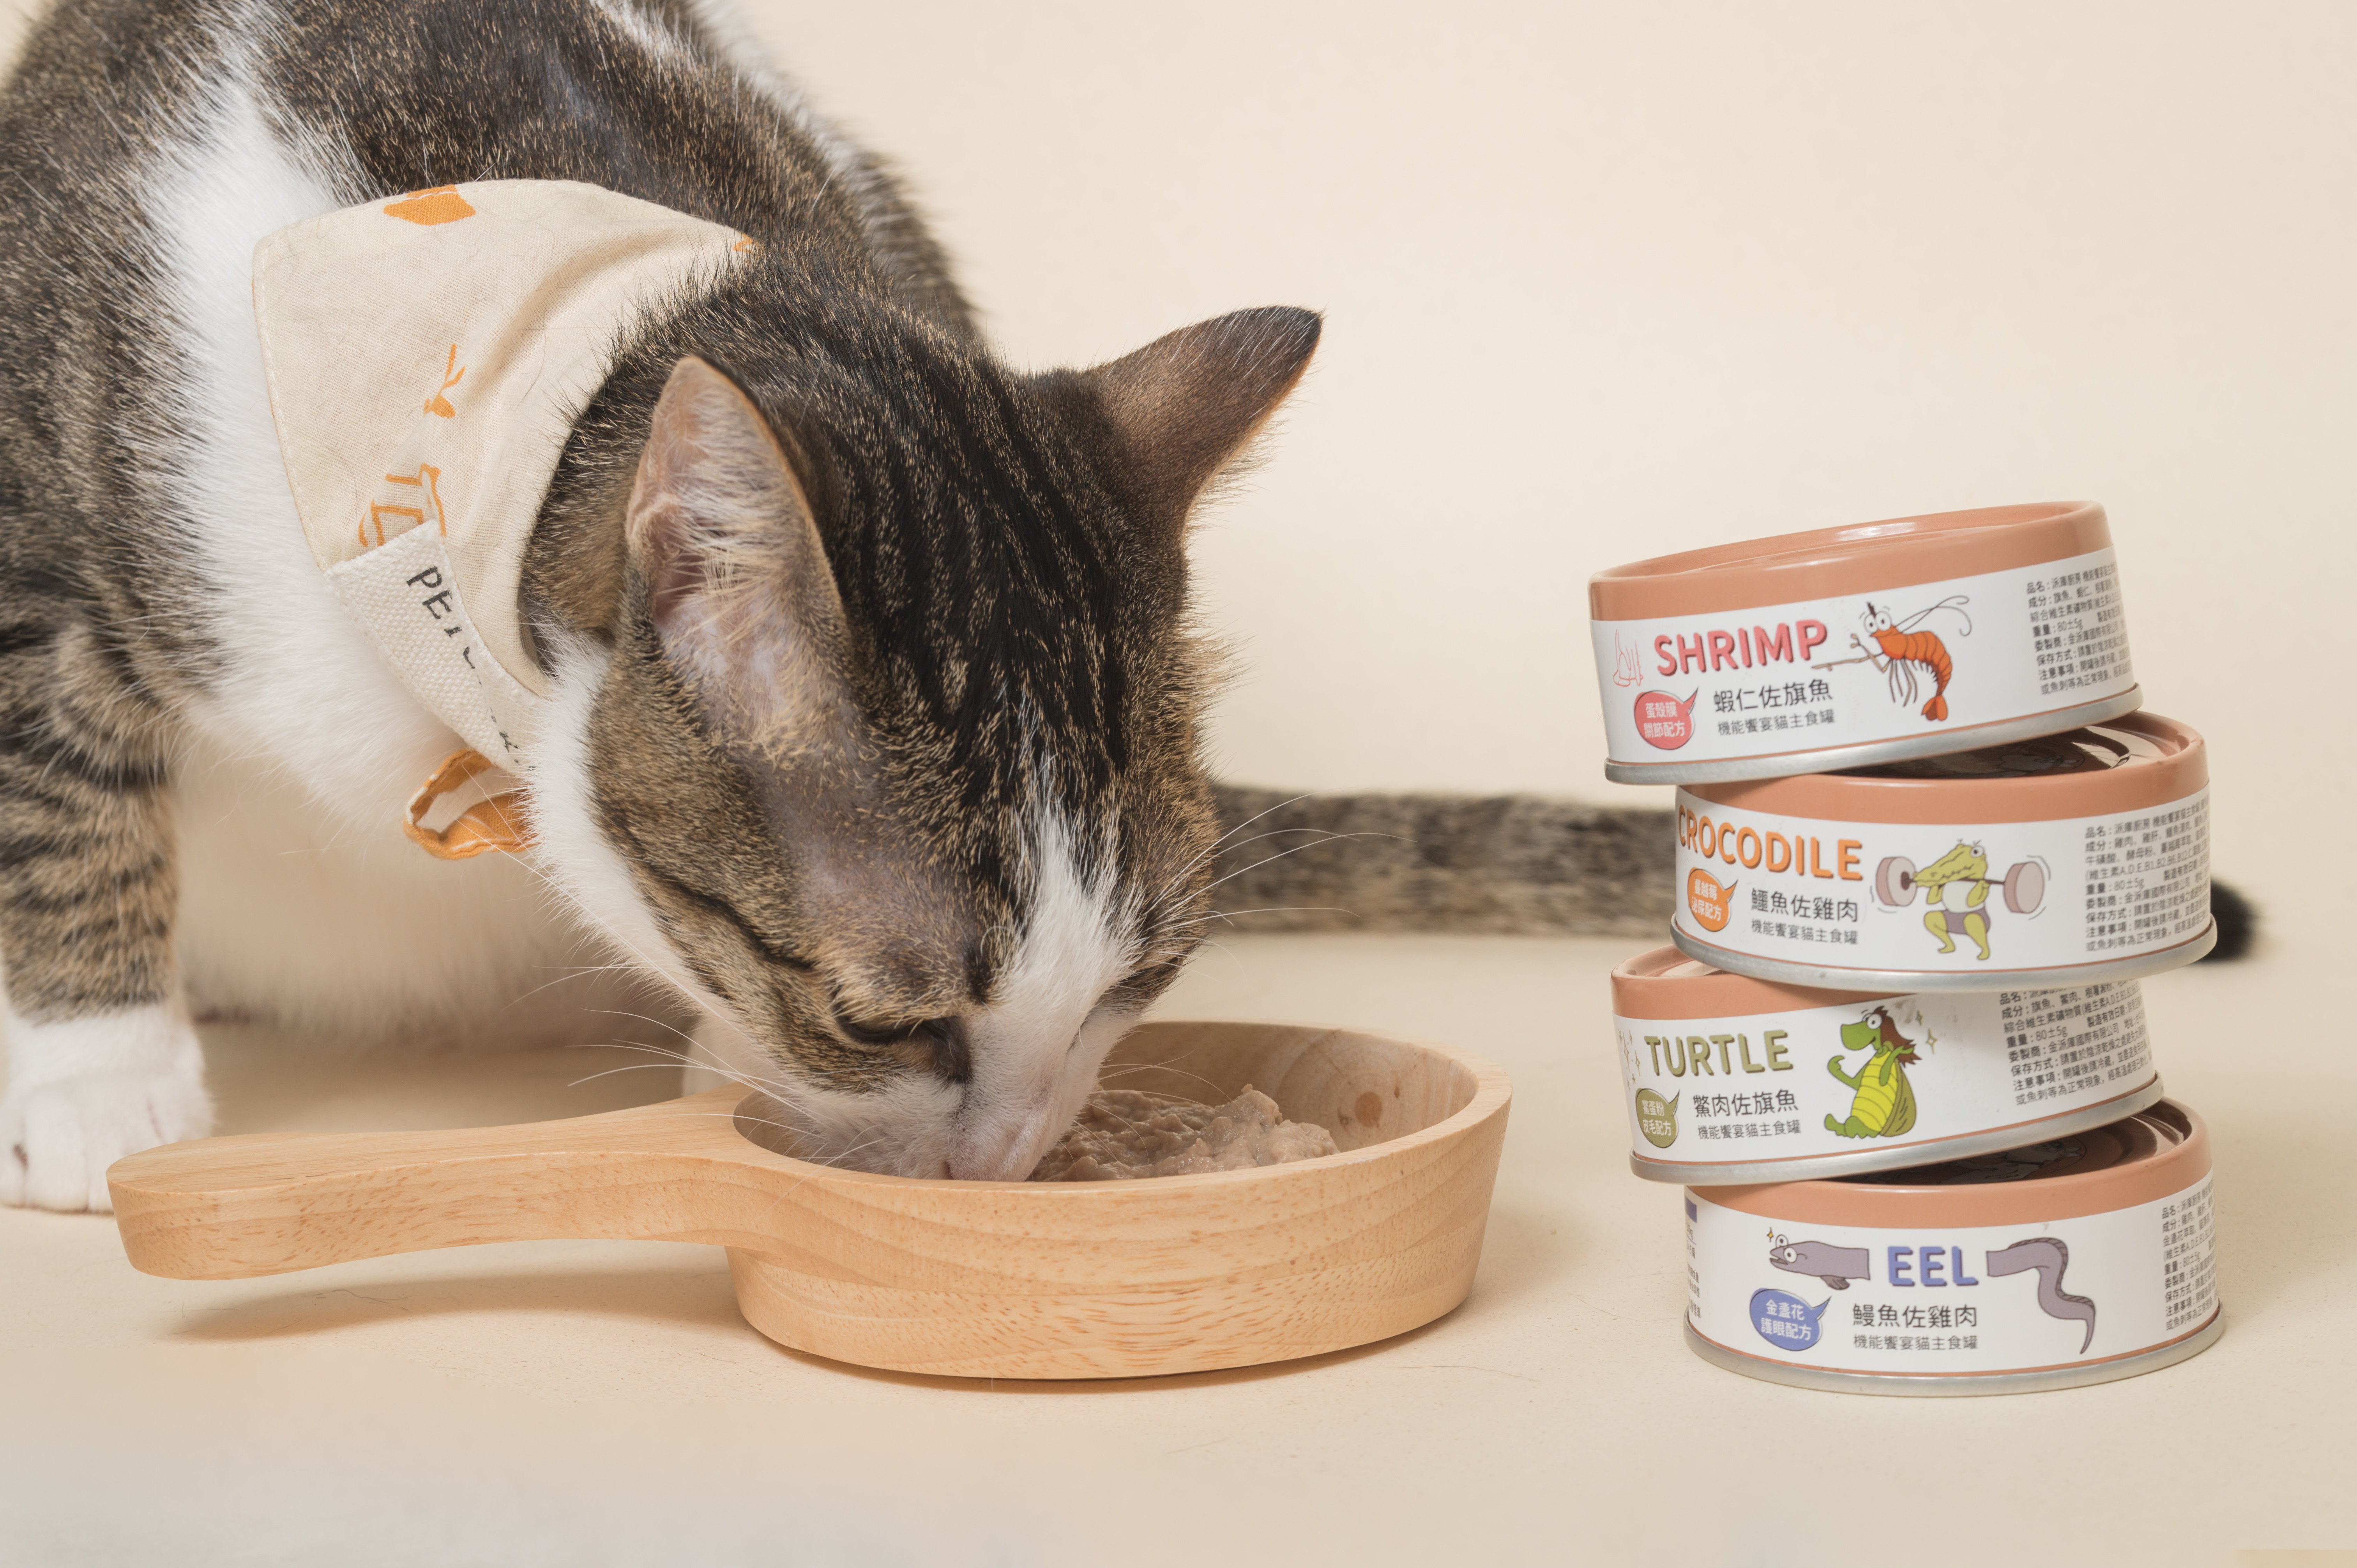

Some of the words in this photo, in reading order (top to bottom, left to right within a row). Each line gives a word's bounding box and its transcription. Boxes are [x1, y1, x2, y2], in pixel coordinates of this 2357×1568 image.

[1654, 619, 1828, 676] SHRIMP
[1714, 678, 1833, 713] 蝦仁佐旗魚
[1645, 702, 1677, 718] 蛋殼膜
[1717, 709, 1835, 736] 機能饗宴貓主食罐
[1643, 720, 1685, 738] 關節配方
[1678, 804, 1863, 881] CROCODILE
[1694, 879, 1717, 901] 蔓越莓
[1692, 896, 1722, 921] 泌尿配方
[1751, 888, 1857, 923] 鱷魚佐雞肉
[1751, 919, 1858, 945] 機能饗宴貓主食罐
[1644, 1029, 1794, 1077] TURTLE
[1693, 1089, 1799, 1118] 鱉肉佐旗魚
[1643, 1118, 1671, 1136] 皮毛配方
[1698, 1119, 1801, 1140] 機能饗宴貓主食罐
[1887, 1246, 1979, 1287] EEL
[1766, 1299, 1805, 1320] 金盞花
[1853, 1303, 1977, 1328] 鰻魚佐雞肉
[1761, 1317, 1812, 1340] 護眼配方
[1853, 1333, 1978, 1351] 機能饗宴貓主食罐
